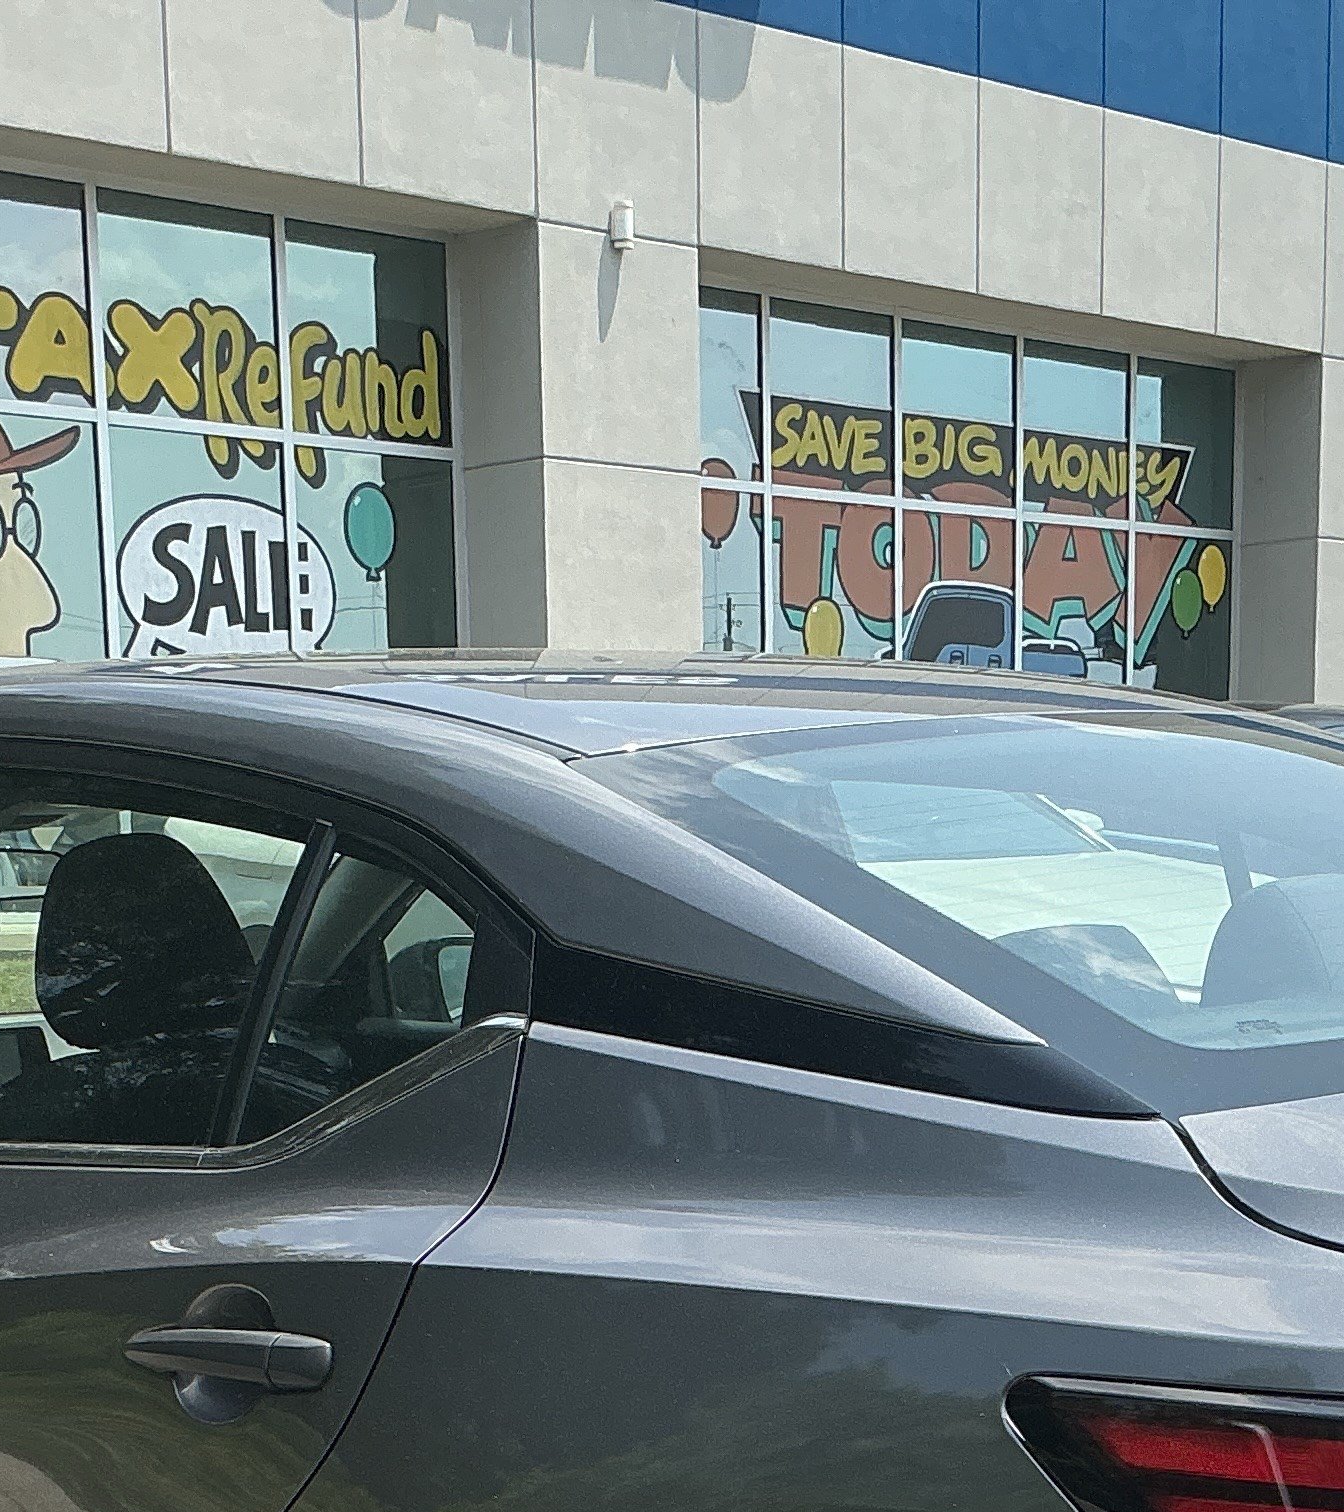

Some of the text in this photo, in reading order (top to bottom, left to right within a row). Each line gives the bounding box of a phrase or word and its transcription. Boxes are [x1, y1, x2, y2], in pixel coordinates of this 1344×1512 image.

[192, 298, 444, 478] Refund
[771, 402, 1183, 508] SAVE BIG MONEY
[141, 522, 314, 636] SALE
[753, 463, 1194, 650] TODAY
